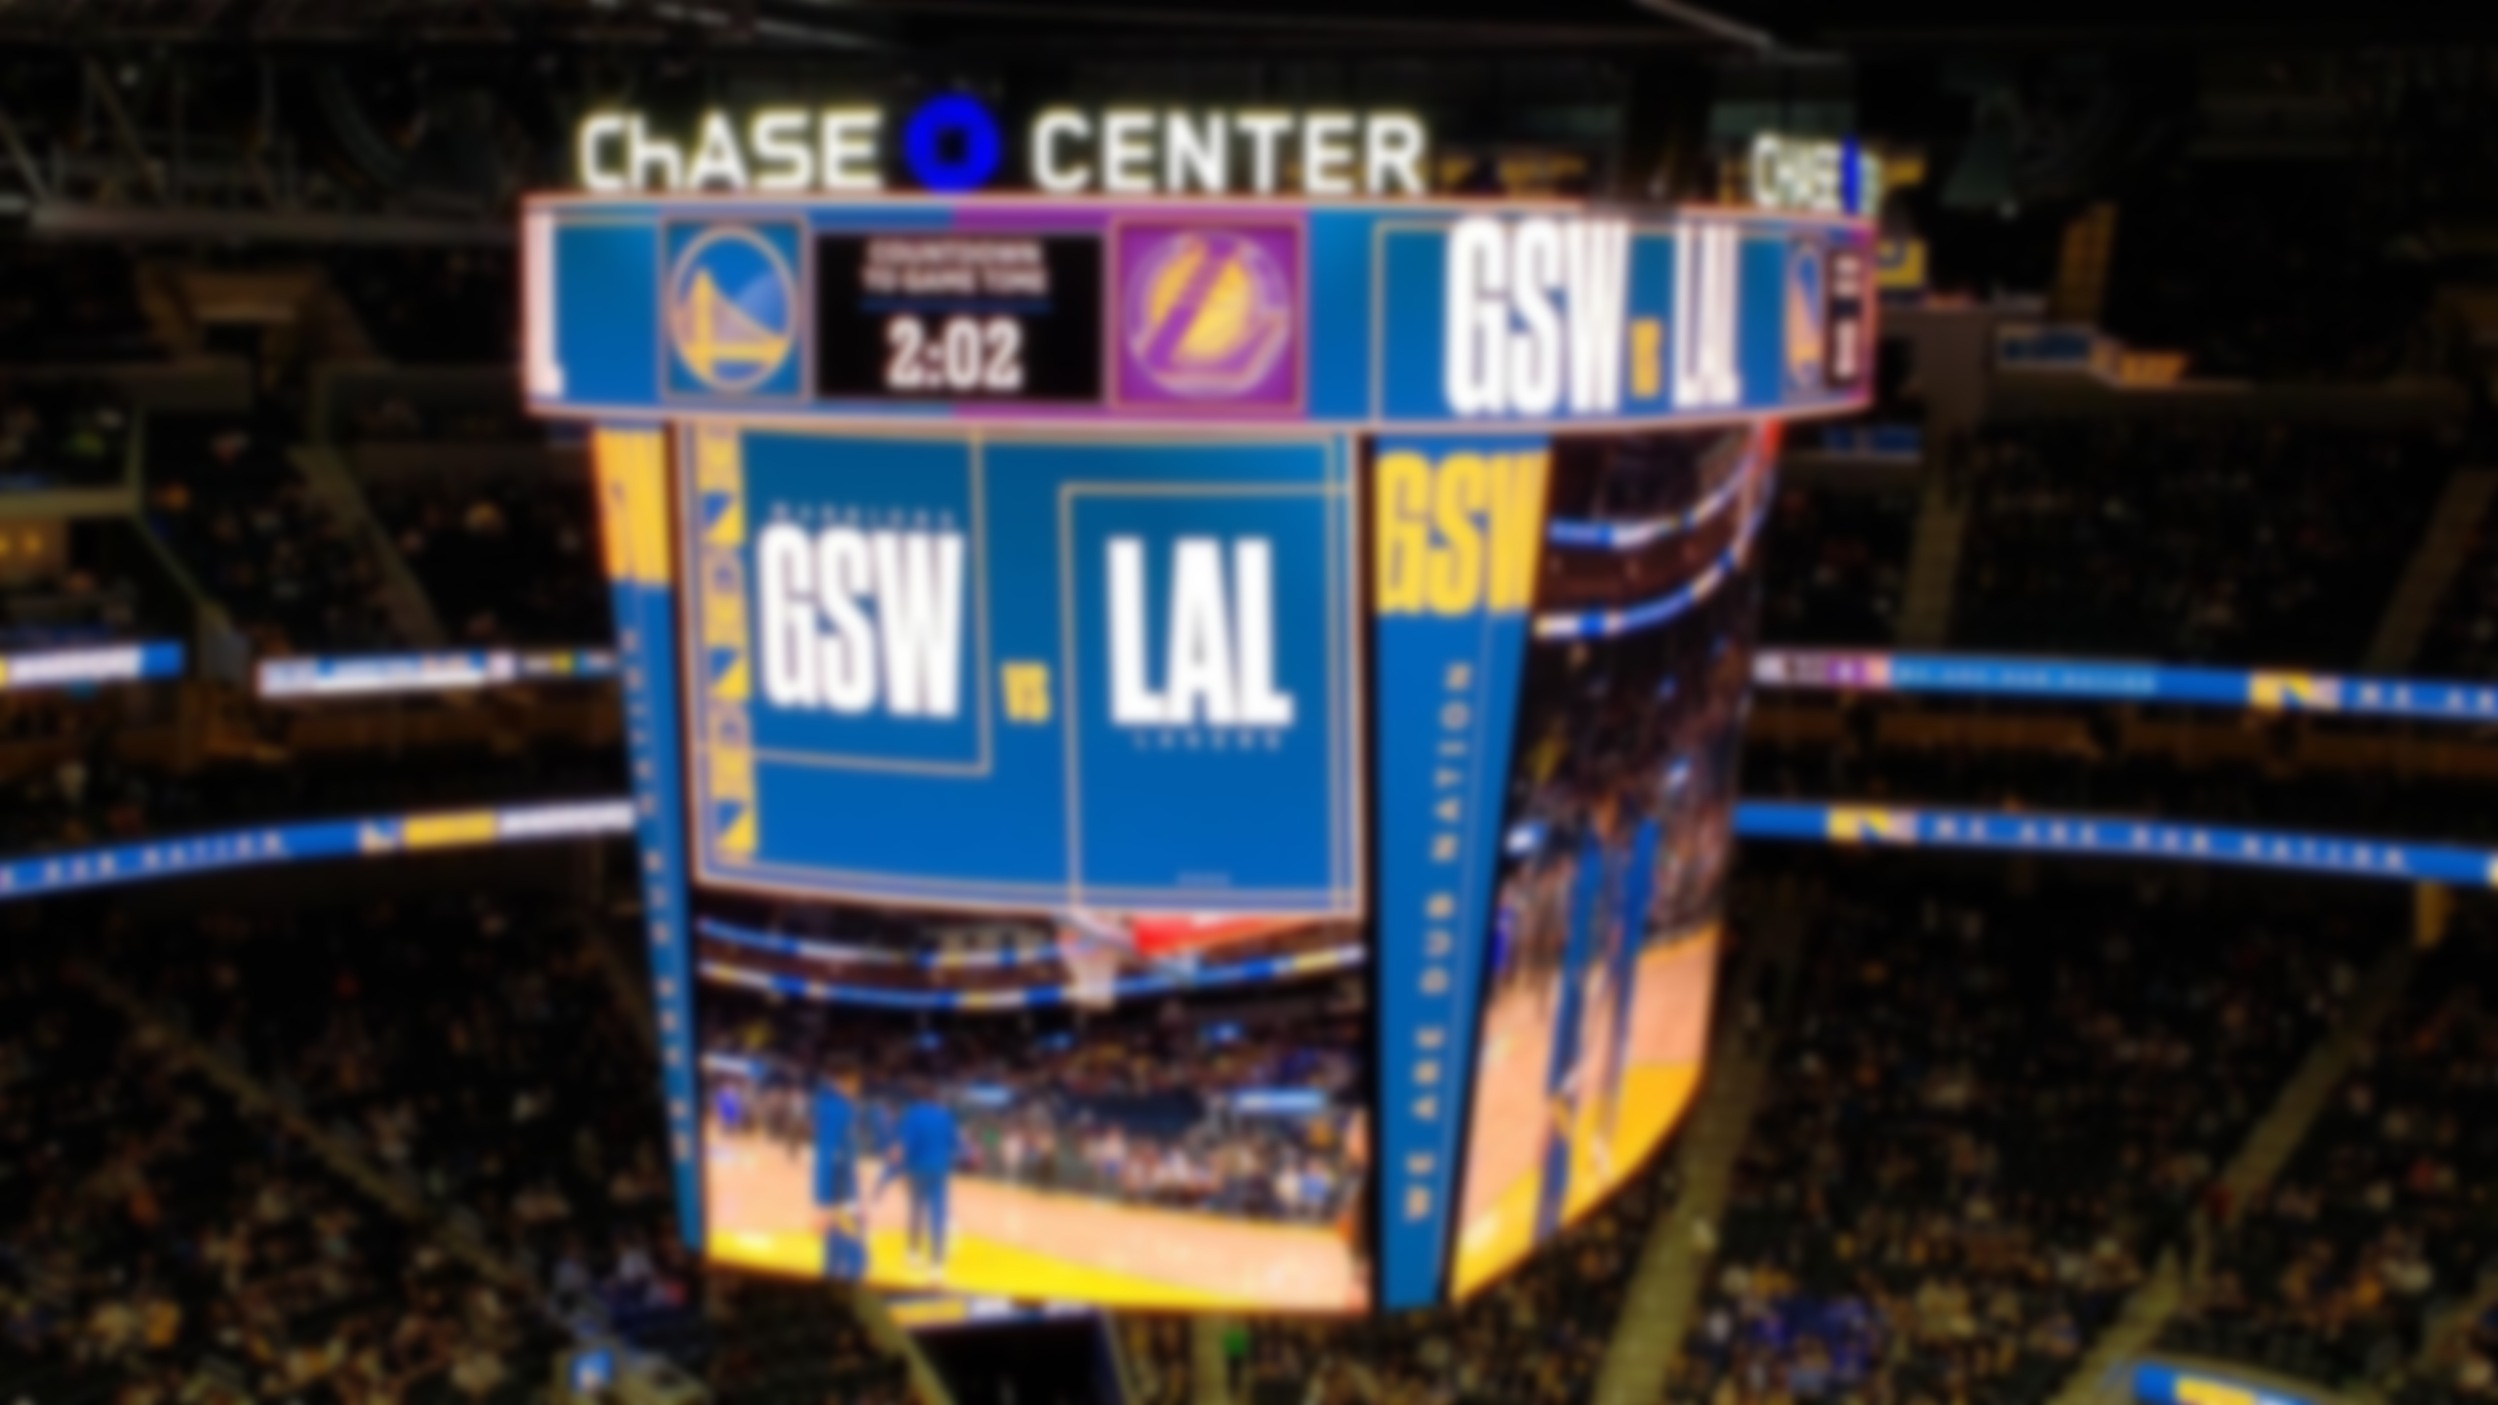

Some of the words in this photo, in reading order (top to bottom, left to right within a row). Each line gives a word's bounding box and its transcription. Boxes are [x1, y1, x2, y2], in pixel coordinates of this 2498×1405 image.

[1032, 110, 1427, 194] CENTER
[863, 267, 897, 292] TO
[903, 267, 977, 292] GAME
[985, 268, 1048, 293] TIME
[868, 240, 1042, 264] COUNTDOWN
[887, 317, 1022, 389] 2:02
[1446, 216, 1628, 415] GSW
[759, 522, 964, 718] GSW
[1106, 538, 1295, 727] LAL
[1001, 662, 1051, 723] VS
[1430, 663, 1473, 861] NATION
[1420, 893, 1454, 994] DUB
[1411, 1025, 1443, 1121] ARE
[1402, 1152, 1435, 1222] WE
